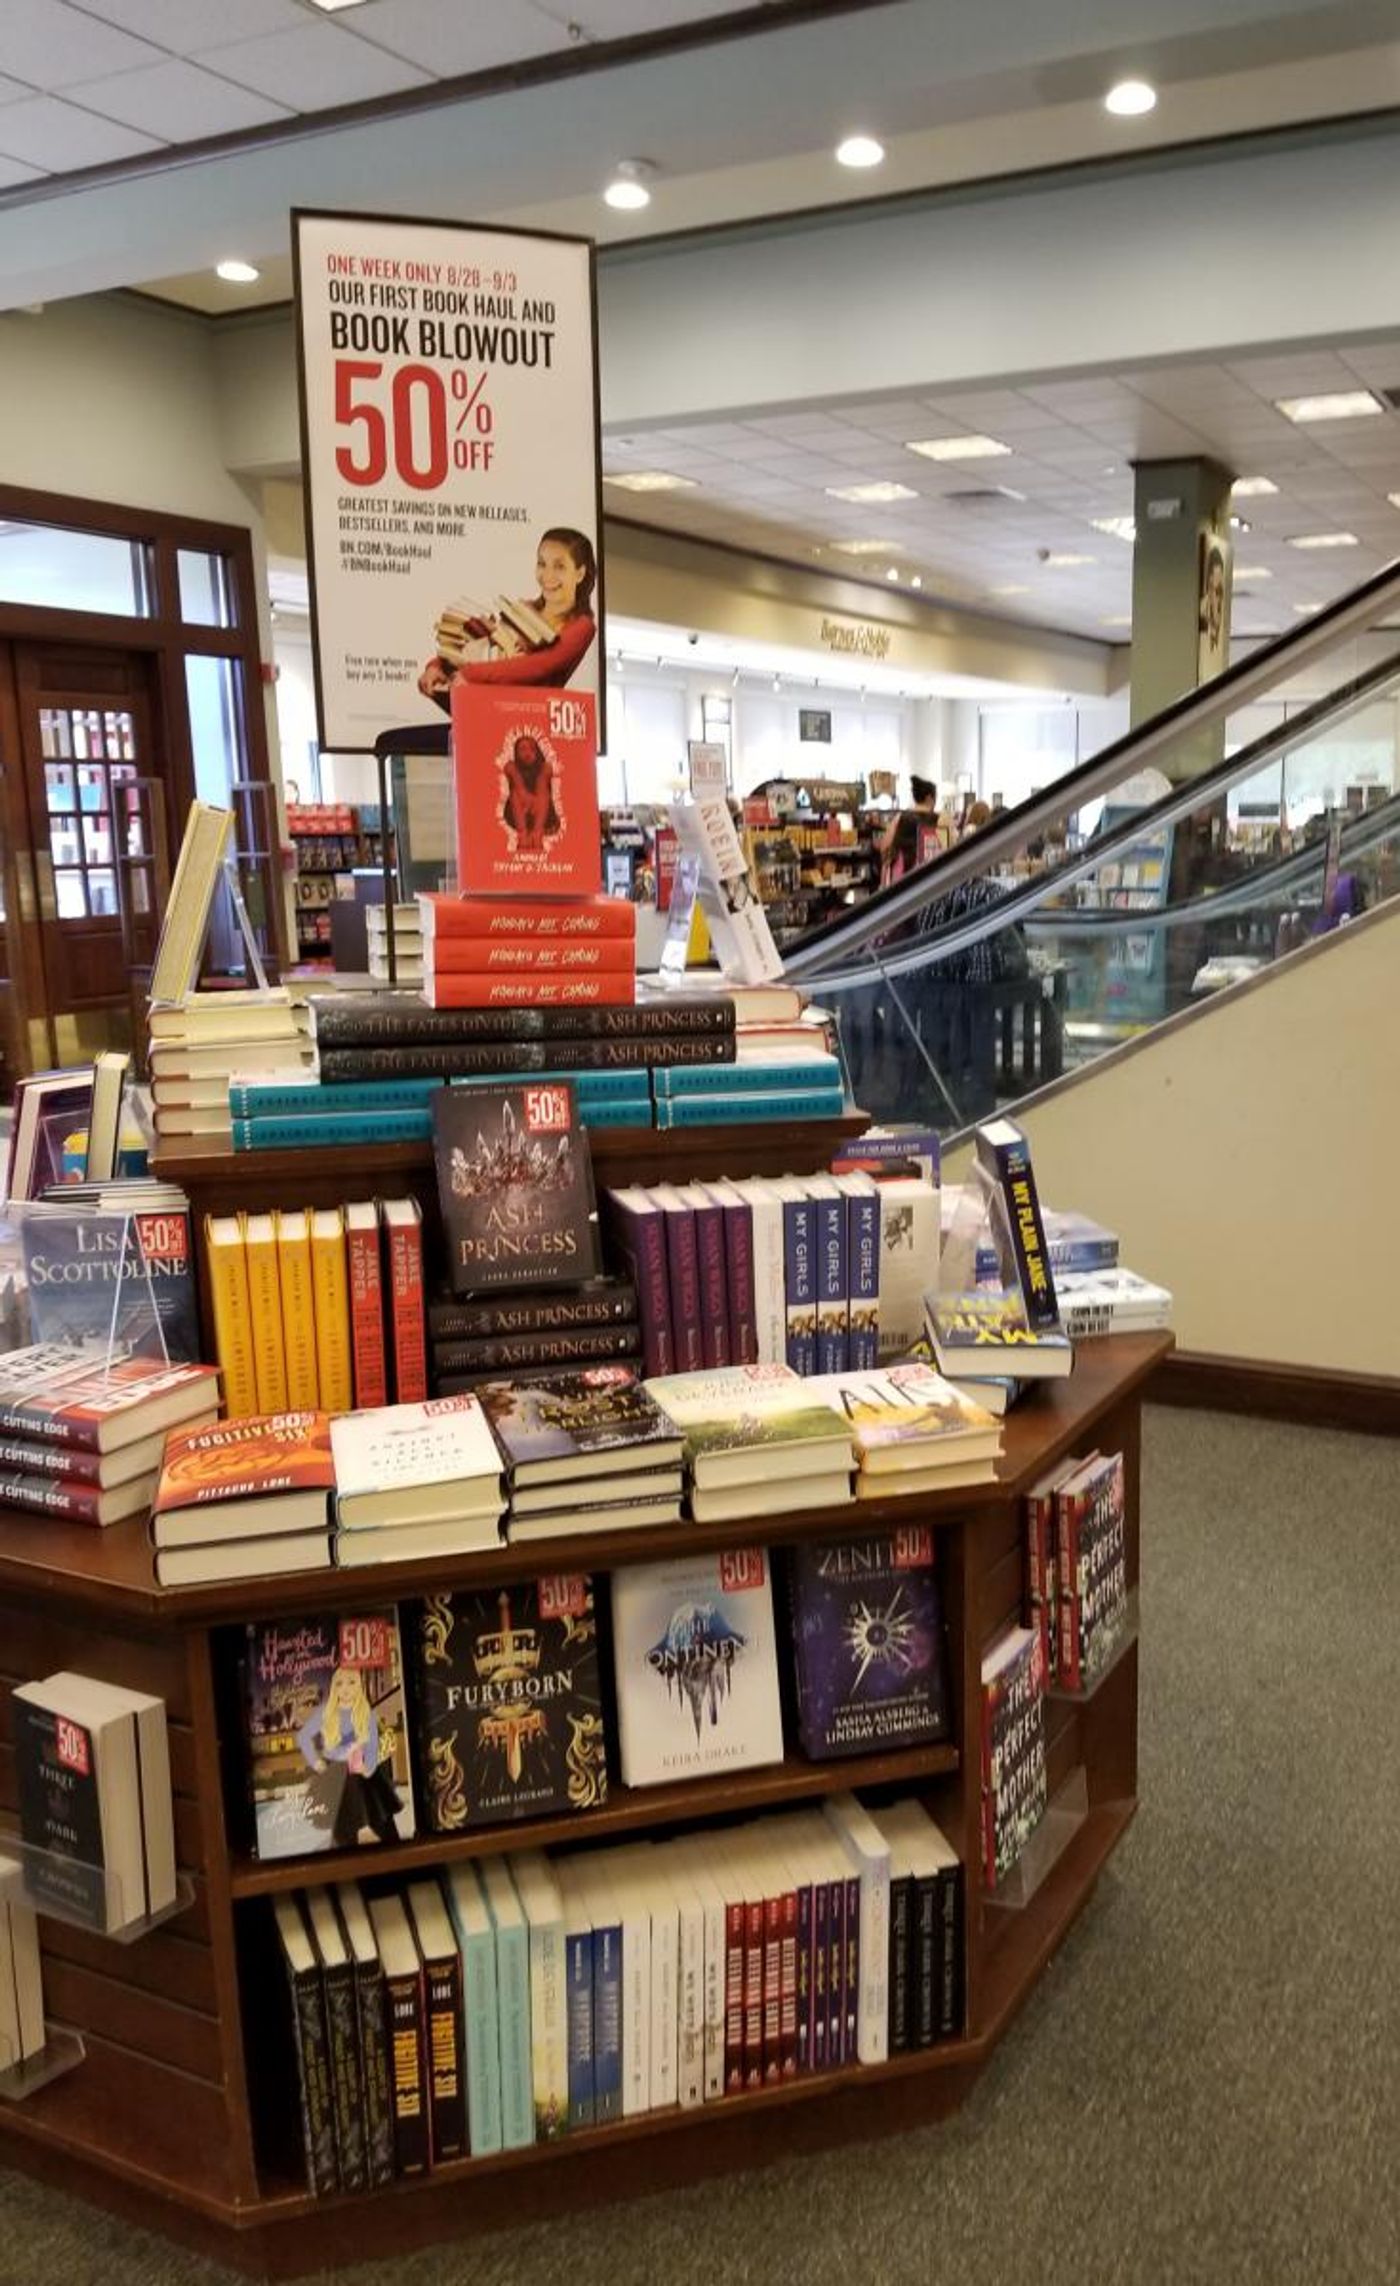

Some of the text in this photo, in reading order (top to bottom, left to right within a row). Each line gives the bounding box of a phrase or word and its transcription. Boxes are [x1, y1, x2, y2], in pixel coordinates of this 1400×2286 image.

[327, 254, 357, 276] ONE
[361, 256, 401, 280] WEEK
[405, 261, 442, 285] ONLY
[328, 279, 556, 325] OUR FIRST BOOK HAUL AND
[330, 311, 556, 370] BOOK BLOWOUT
[453, 439, 495, 473] OFF
[337, 496, 388, 514] GREATEST
[392, 499, 436, 516] SAVINGS
[438, 503, 452, 517] ON
[453, 504, 478, 519] NEW
[413, 520, 434, 535] AND
[606, 1013, 637, 1032] ASH
[642, 1012, 712, 1031] PRINCESS
[607, 1044, 713, 1062] ASH PRINCESS
[460, 1205, 578, 1266] ASH PRINCESS
[826, 1208, 840, 1294] MY GIRLS
[859, 1206, 873, 1291] MY GIRLS
[795, 1211, 809, 1297] MY GIRLS
[496, 1310, 531, 1329] ASH
[536, 1302, 611, 1327] PRINCESS
[501, 1345, 534, 1363] ASH
[540, 1336, 614, 1358] PRINCESS
[44, 1421, 69, 1437] EDGE
[274, 1426, 308, 1442] SIX
[46, 1455, 71, 1471] EDGE
[45, 1493, 70, 1508] EDGE
[818, 1541, 896, 1576] ZENIT
[1081, 1518, 1124, 1580] PERFECT
[446, 1668, 574, 1710] FURYBORN
[995, 1697, 1042, 1771] PERFECT
[997, 1740, 1043, 1818] MOTHER
